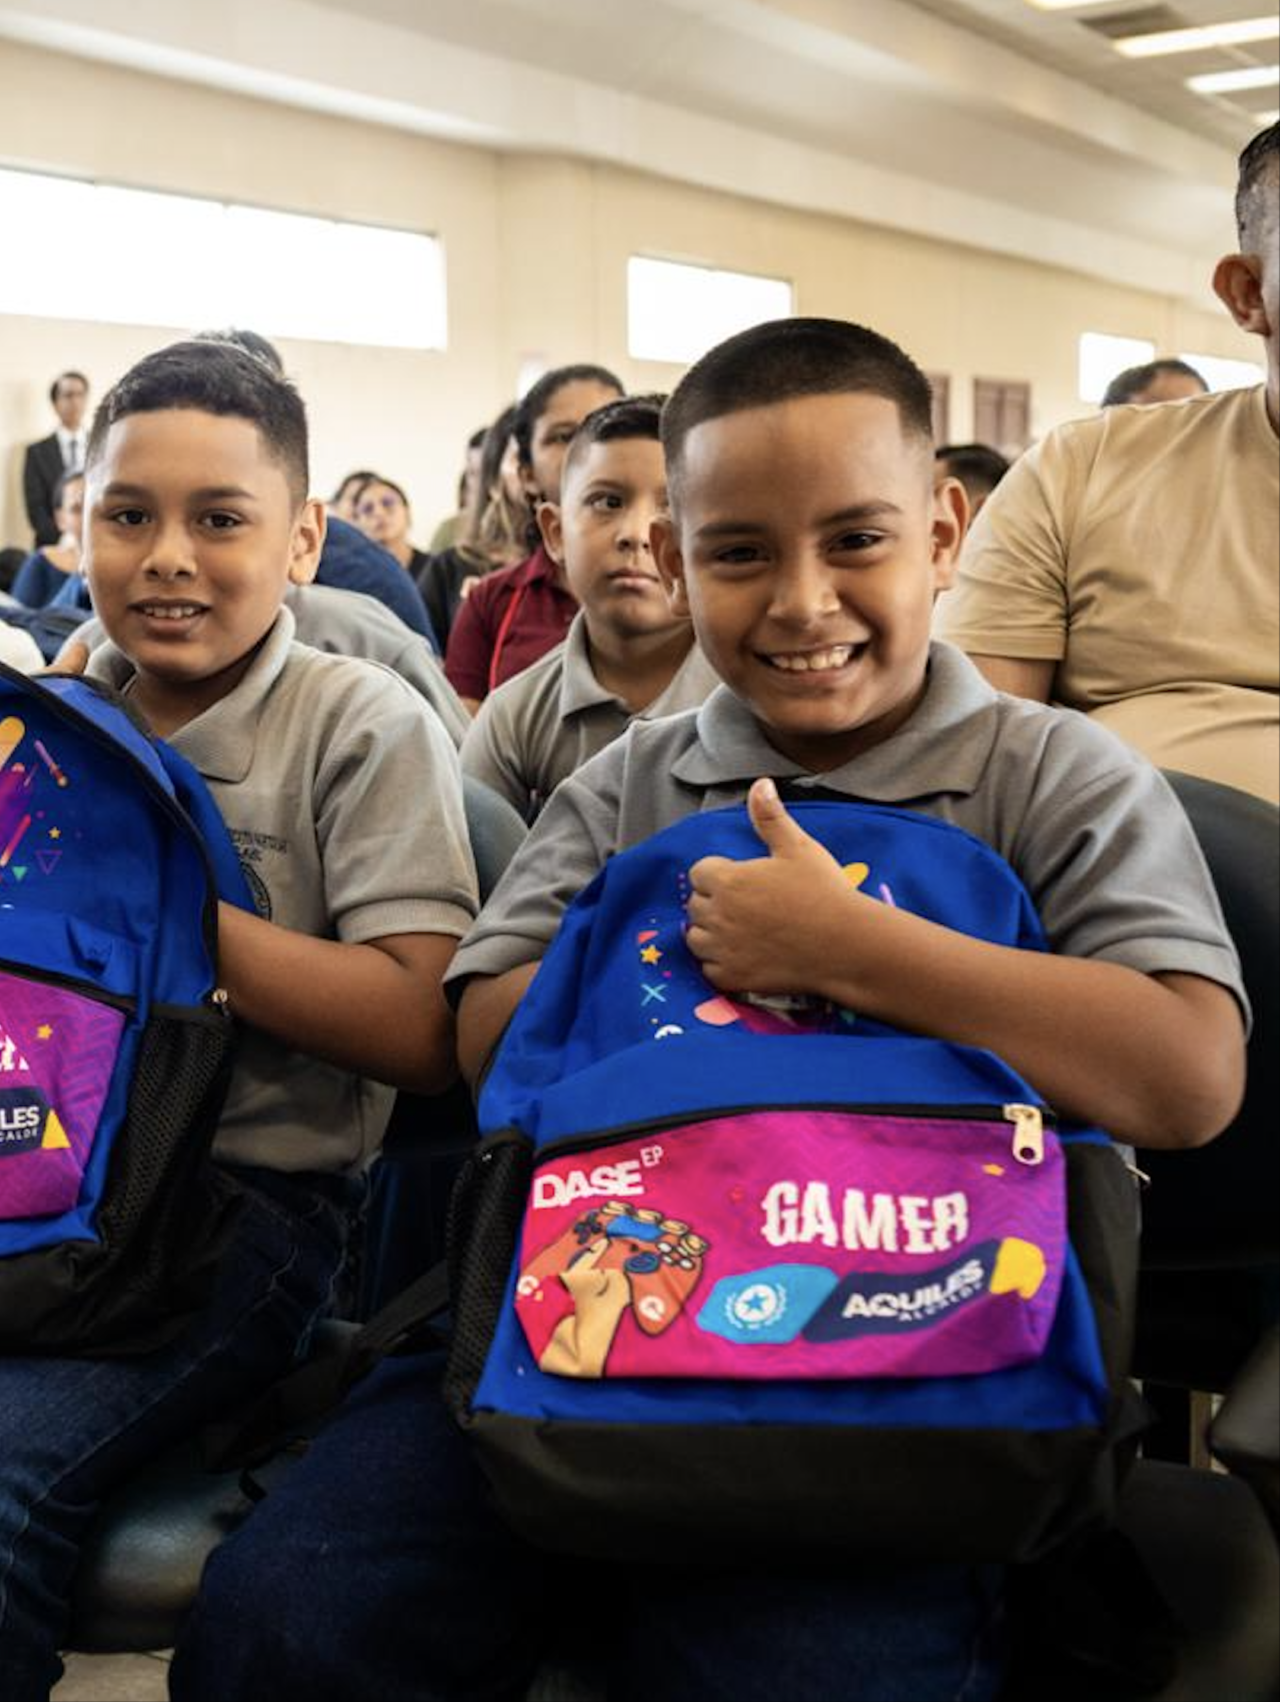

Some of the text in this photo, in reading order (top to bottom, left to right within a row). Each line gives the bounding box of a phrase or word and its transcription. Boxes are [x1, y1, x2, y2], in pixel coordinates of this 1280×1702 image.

[532, 1145, 664, 1209] DASE EP
[760, 1180, 969, 1255] GAMER
[841, 1258, 986, 1319] AQUILES
